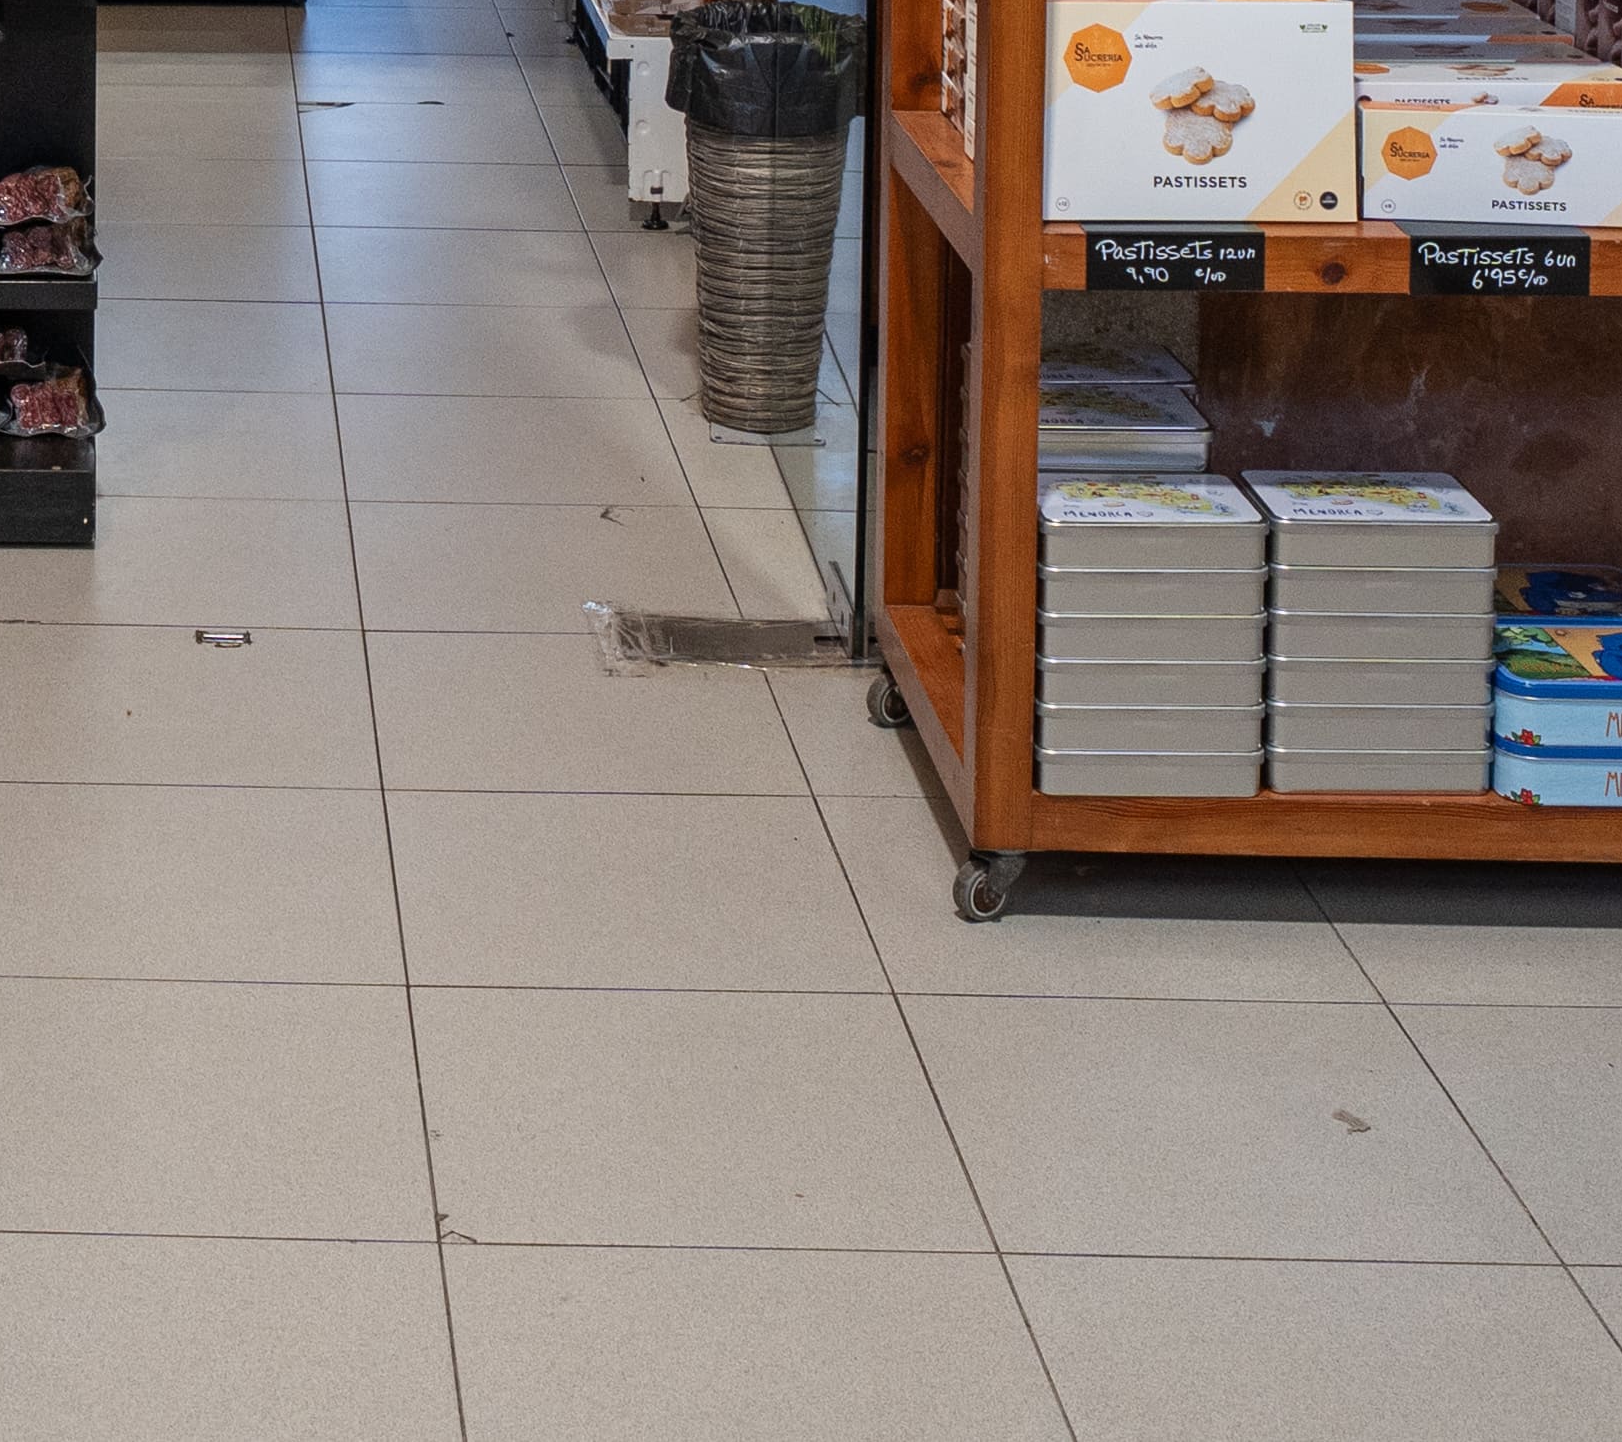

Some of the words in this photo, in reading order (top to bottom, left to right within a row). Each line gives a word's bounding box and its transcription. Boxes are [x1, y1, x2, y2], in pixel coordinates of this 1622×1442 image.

[1075, 51, 1123, 62] SUCRERIA
[1390, 149, 1430, 159] SUCRERIA
[1153, 176, 1247, 189] PASTISSETS
[1492, 200, 1567, 212] PASTISSETS
